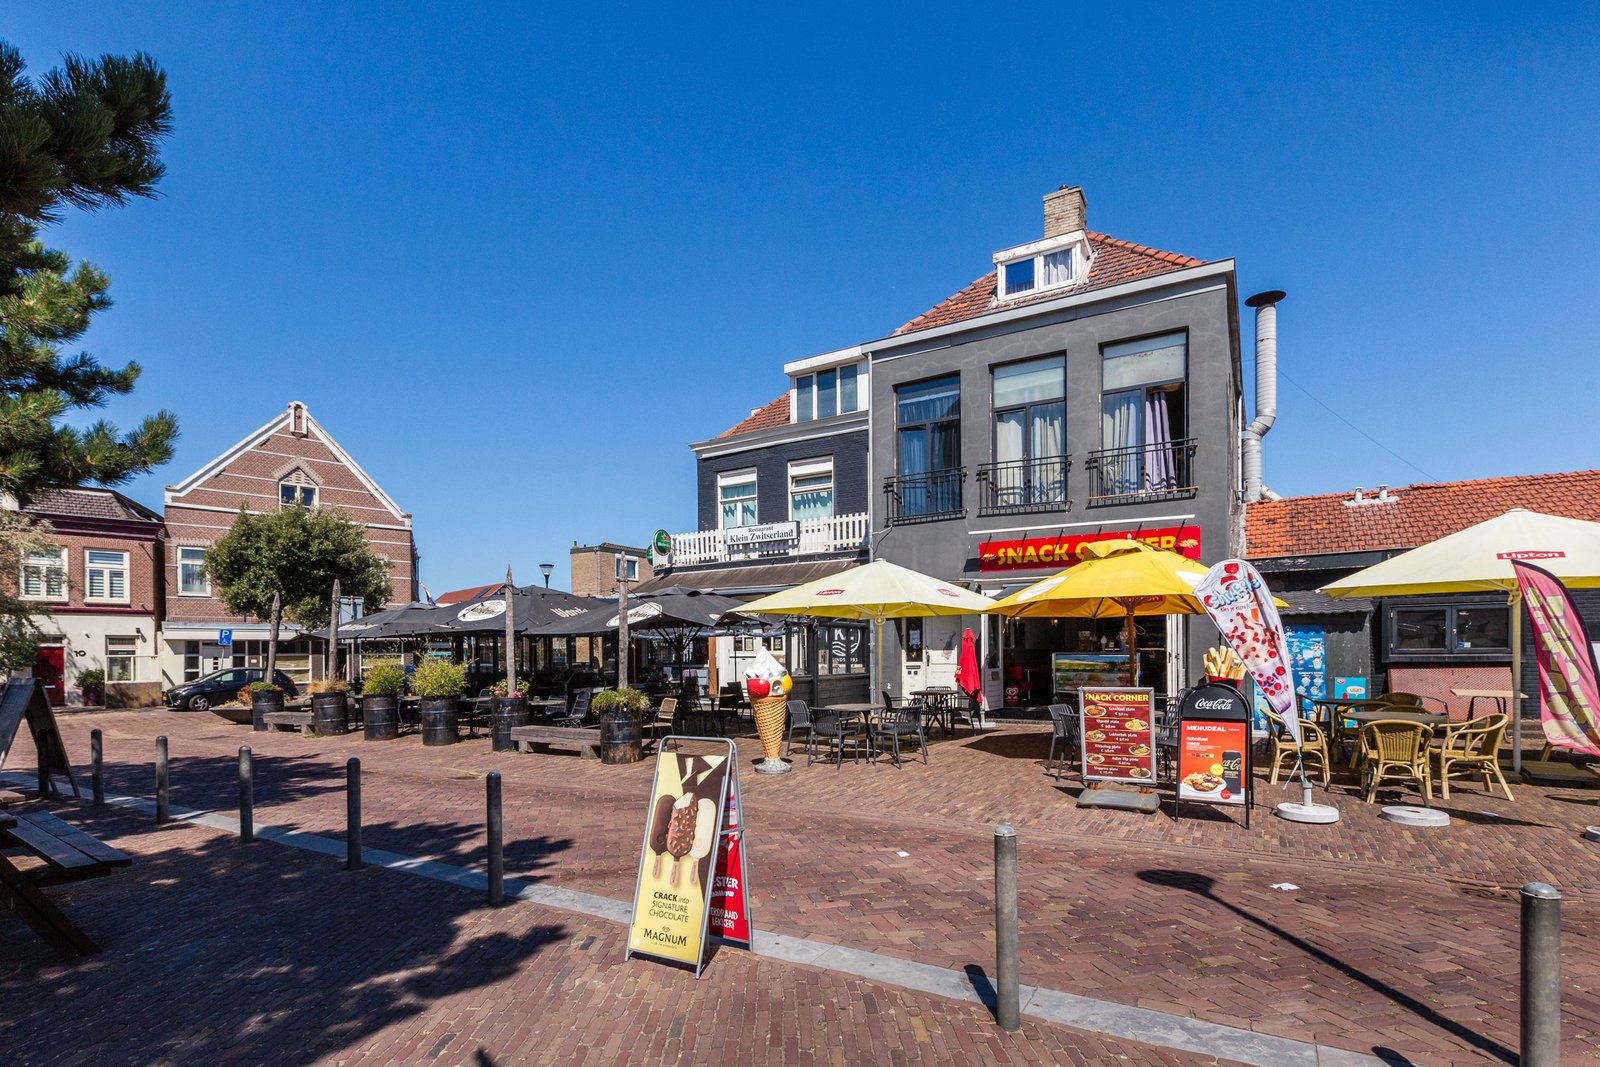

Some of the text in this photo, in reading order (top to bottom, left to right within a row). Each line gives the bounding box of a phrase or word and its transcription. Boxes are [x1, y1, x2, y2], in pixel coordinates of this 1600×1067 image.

[749, 525, 773, 533] Restaurant
[730, 529, 794, 543] Klein Zwitserland
[997, 535, 1177, 565] SNACK CER
[1502, 551, 1560, 559] Lipton
[222, 630, 230, 638] P
[1085, 693, 1149, 702] SNACK CORNER
[1194, 698, 1234, 710] Coca-Cola
[653, 891, 678, 902] CRACK
[652, 900, 688, 913] SIGNATURE
[649, 908, 689, 923] CHOCOLATE
[643, 928, 687, 947] MAGNUM
